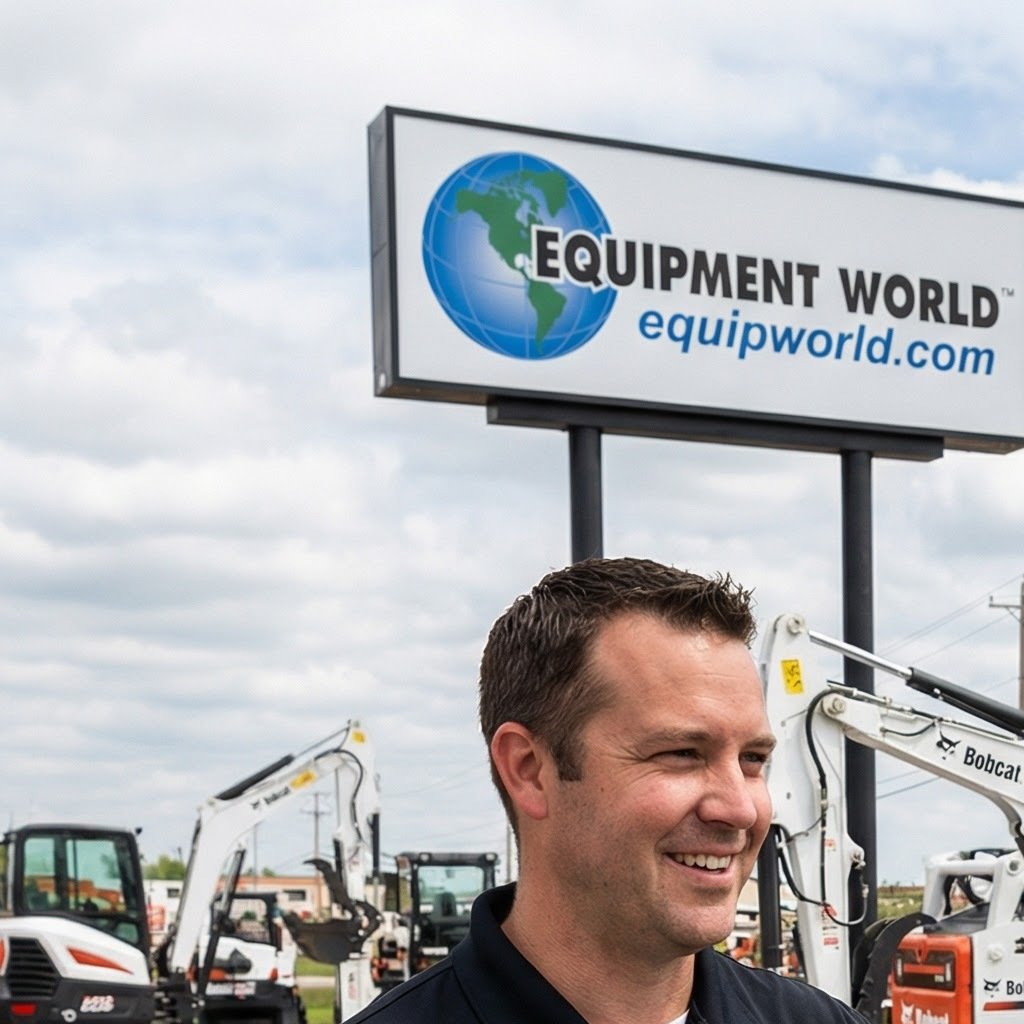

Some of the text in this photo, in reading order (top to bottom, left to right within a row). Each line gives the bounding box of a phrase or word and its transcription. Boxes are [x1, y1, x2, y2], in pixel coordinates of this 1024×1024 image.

[535, 230, 819, 309] EQUIPMENT
[838, 268, 1000, 329] WORLD
[638, 308, 996, 375] equipworld.com
[963, 745, 1021, 783] Bobcat
